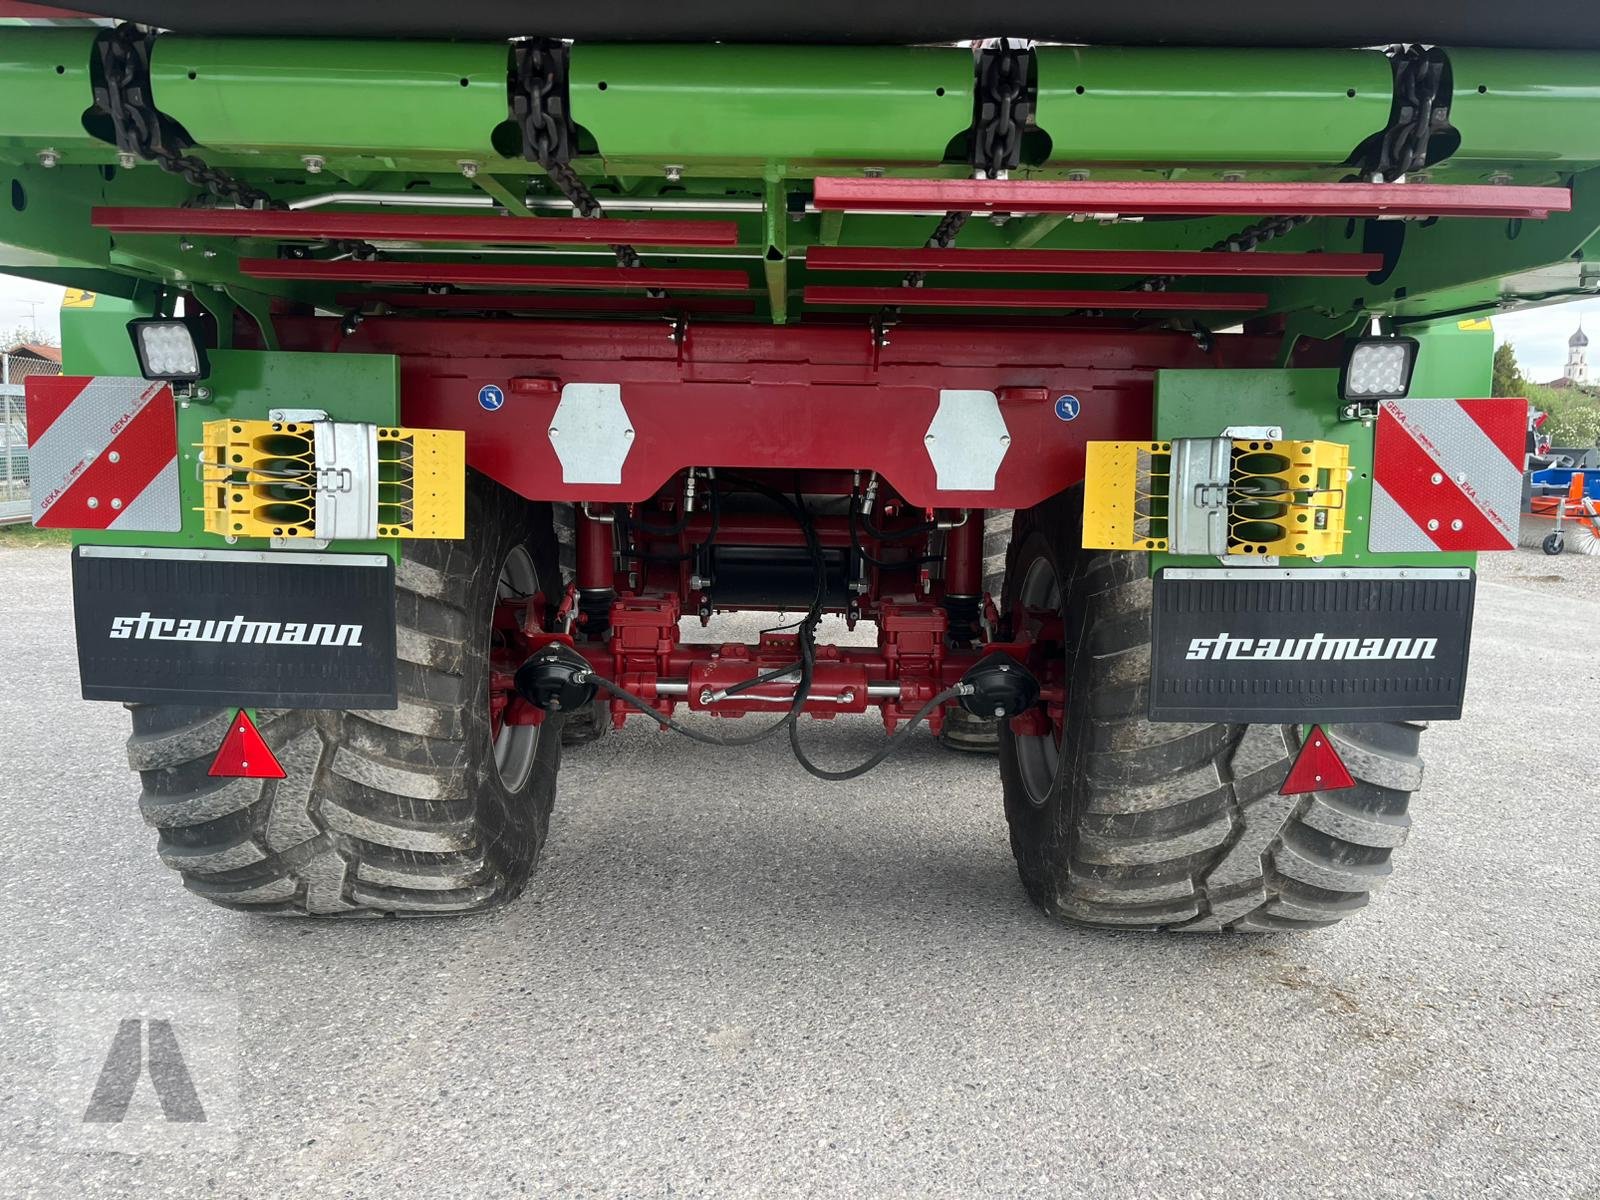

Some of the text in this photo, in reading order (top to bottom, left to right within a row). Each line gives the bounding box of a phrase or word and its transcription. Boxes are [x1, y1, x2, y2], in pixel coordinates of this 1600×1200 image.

[1387, 400, 1407, 423] GEKA
[110, 413, 131, 435] GEKA
[40, 488, 62, 509] GEKA
[1461, 481, 1477, 498] EKA
[109, 611, 364, 647] strautmann
[1185, 632, 1438, 661] strautmann
